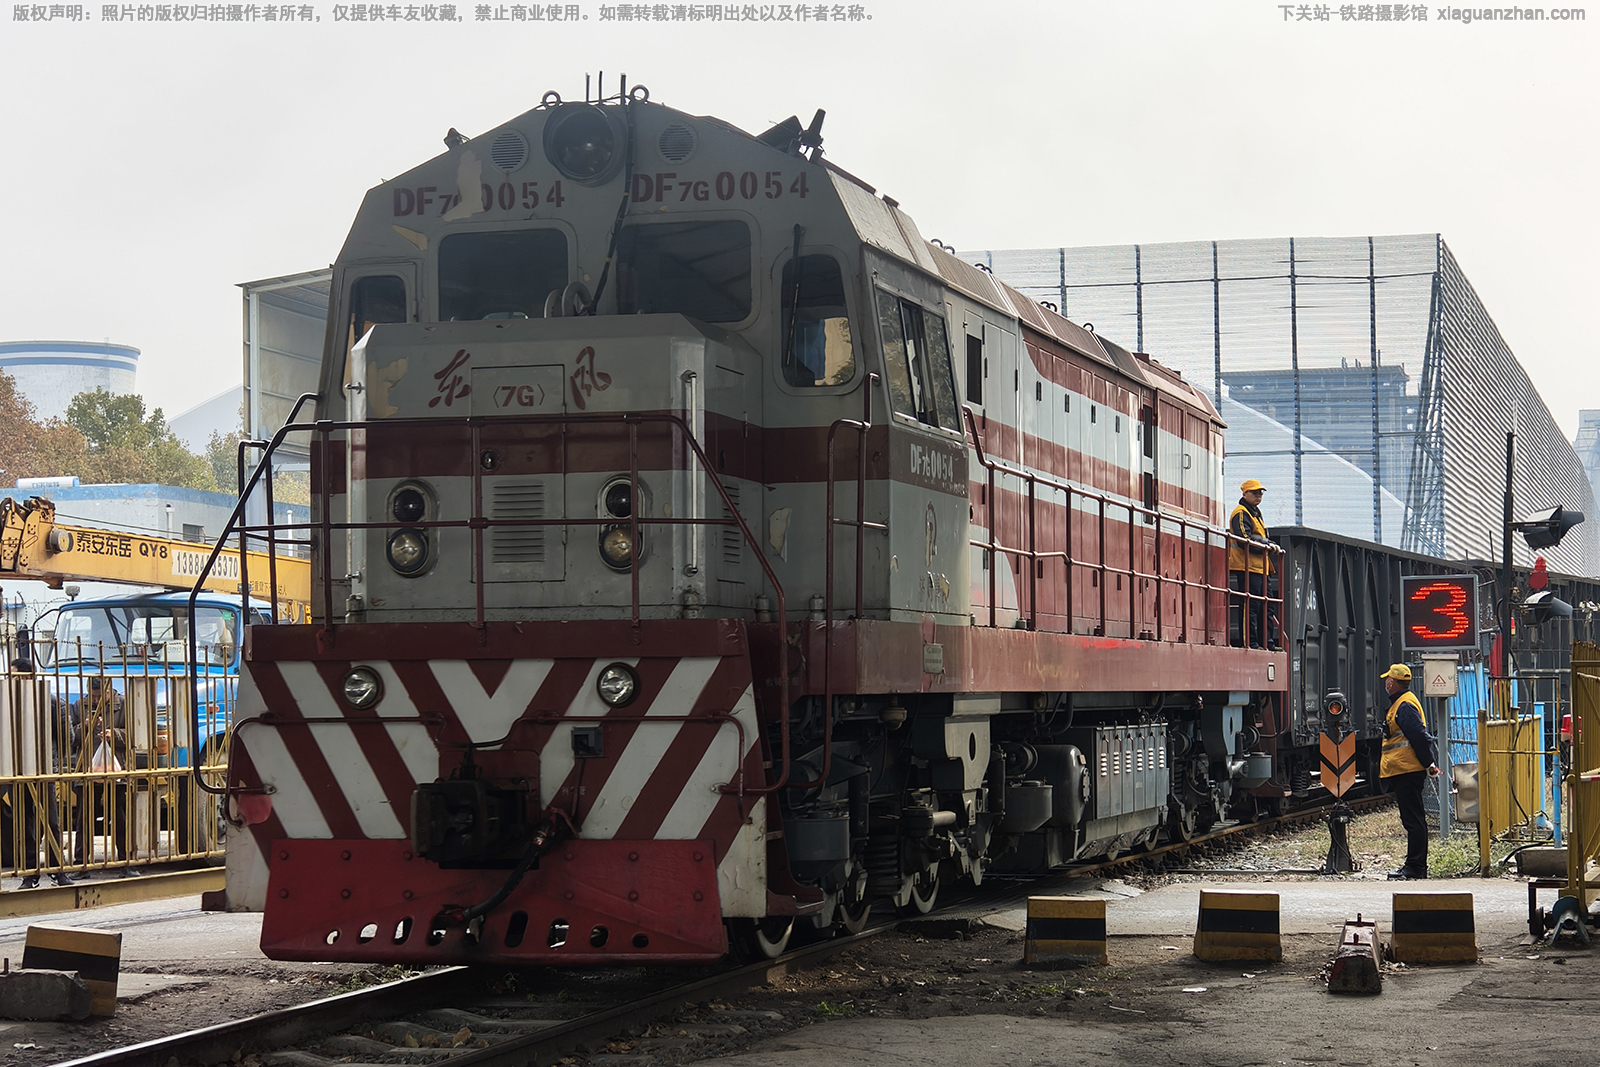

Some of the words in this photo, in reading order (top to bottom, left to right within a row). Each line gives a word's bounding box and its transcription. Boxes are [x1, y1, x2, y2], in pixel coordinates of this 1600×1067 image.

[77, 532, 131, 558] 泰安东岳
[139, 542, 168, 559] QY8
[1411, 582, 1469, 639] 3
